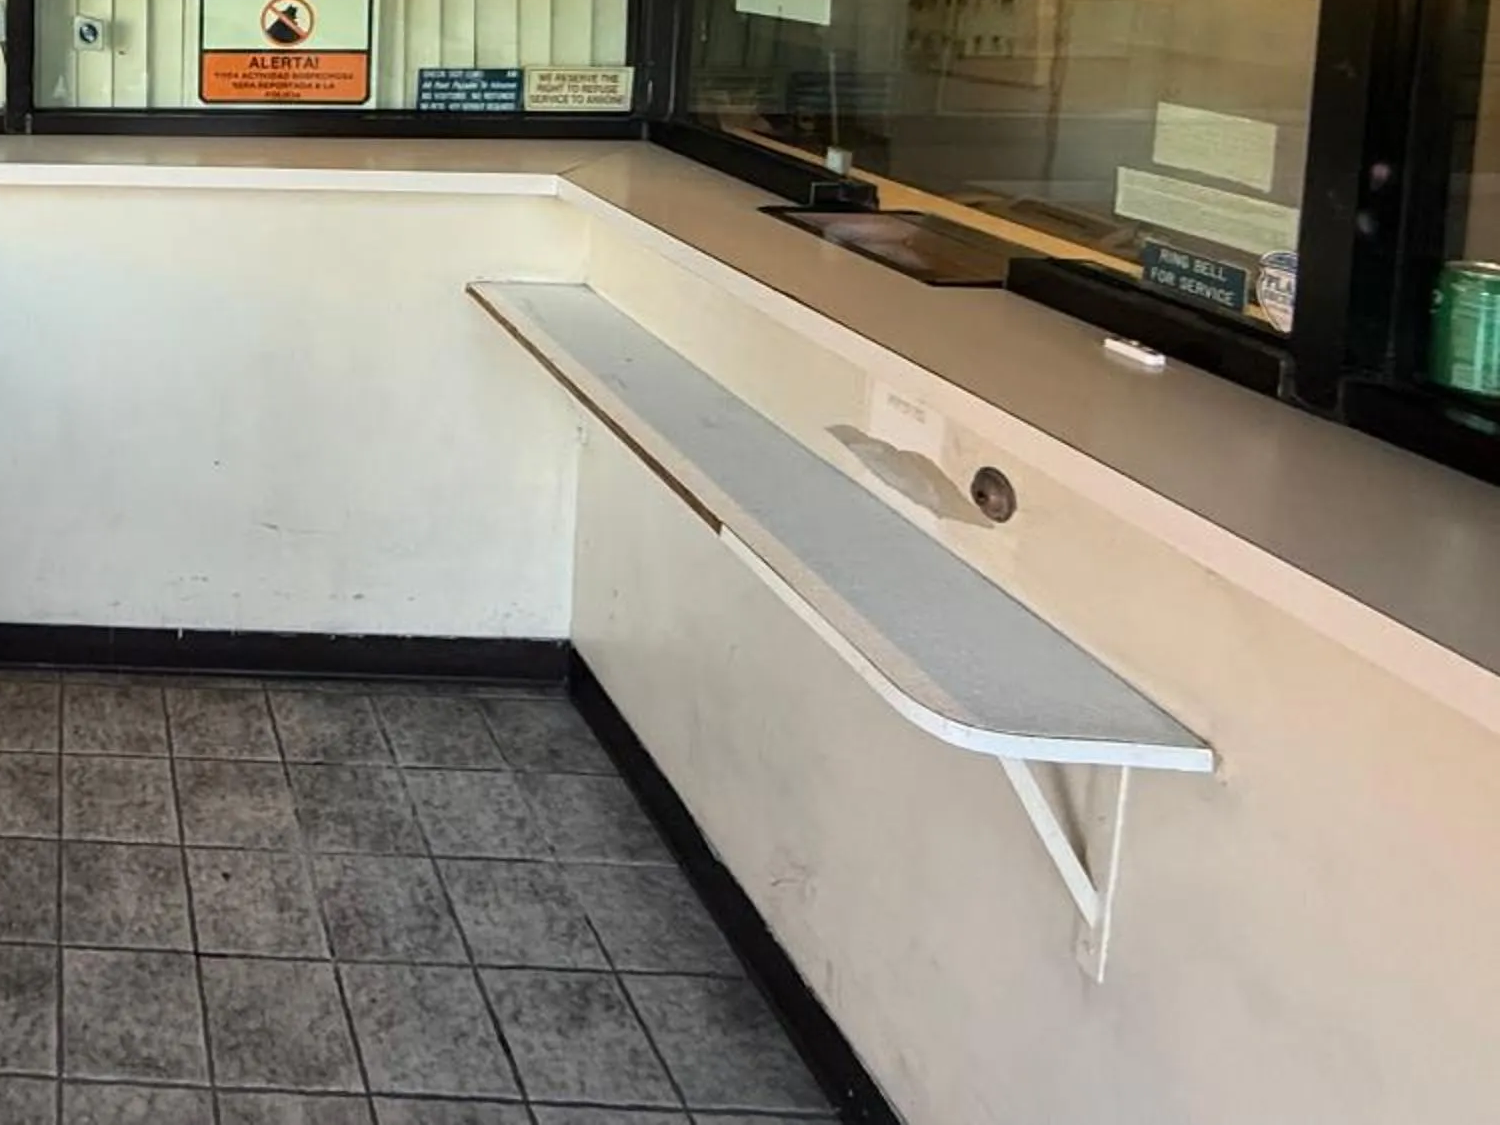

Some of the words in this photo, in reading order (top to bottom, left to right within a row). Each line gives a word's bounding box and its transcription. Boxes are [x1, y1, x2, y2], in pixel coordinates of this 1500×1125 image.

[249, 56, 320, 70] ALERTA!
[241, 72, 289, 80] ACTIVIDAD
[554, 74, 598, 83] RESERVE
[601, 74, 619, 83] THE
[537, 84, 564, 93] RIGHT
[567, 84, 580, 93] TO
[581, 84, 618, 93] REFUSE
[530, 94, 569, 104] SERVICE
[571, 94, 584, 104] TO
[1158, 248, 1190, 270] RING
[1192, 259, 1227, 283] BELL
[1150, 266, 1177, 287] FOR
[1178, 276, 1236, 308] SERVICE
